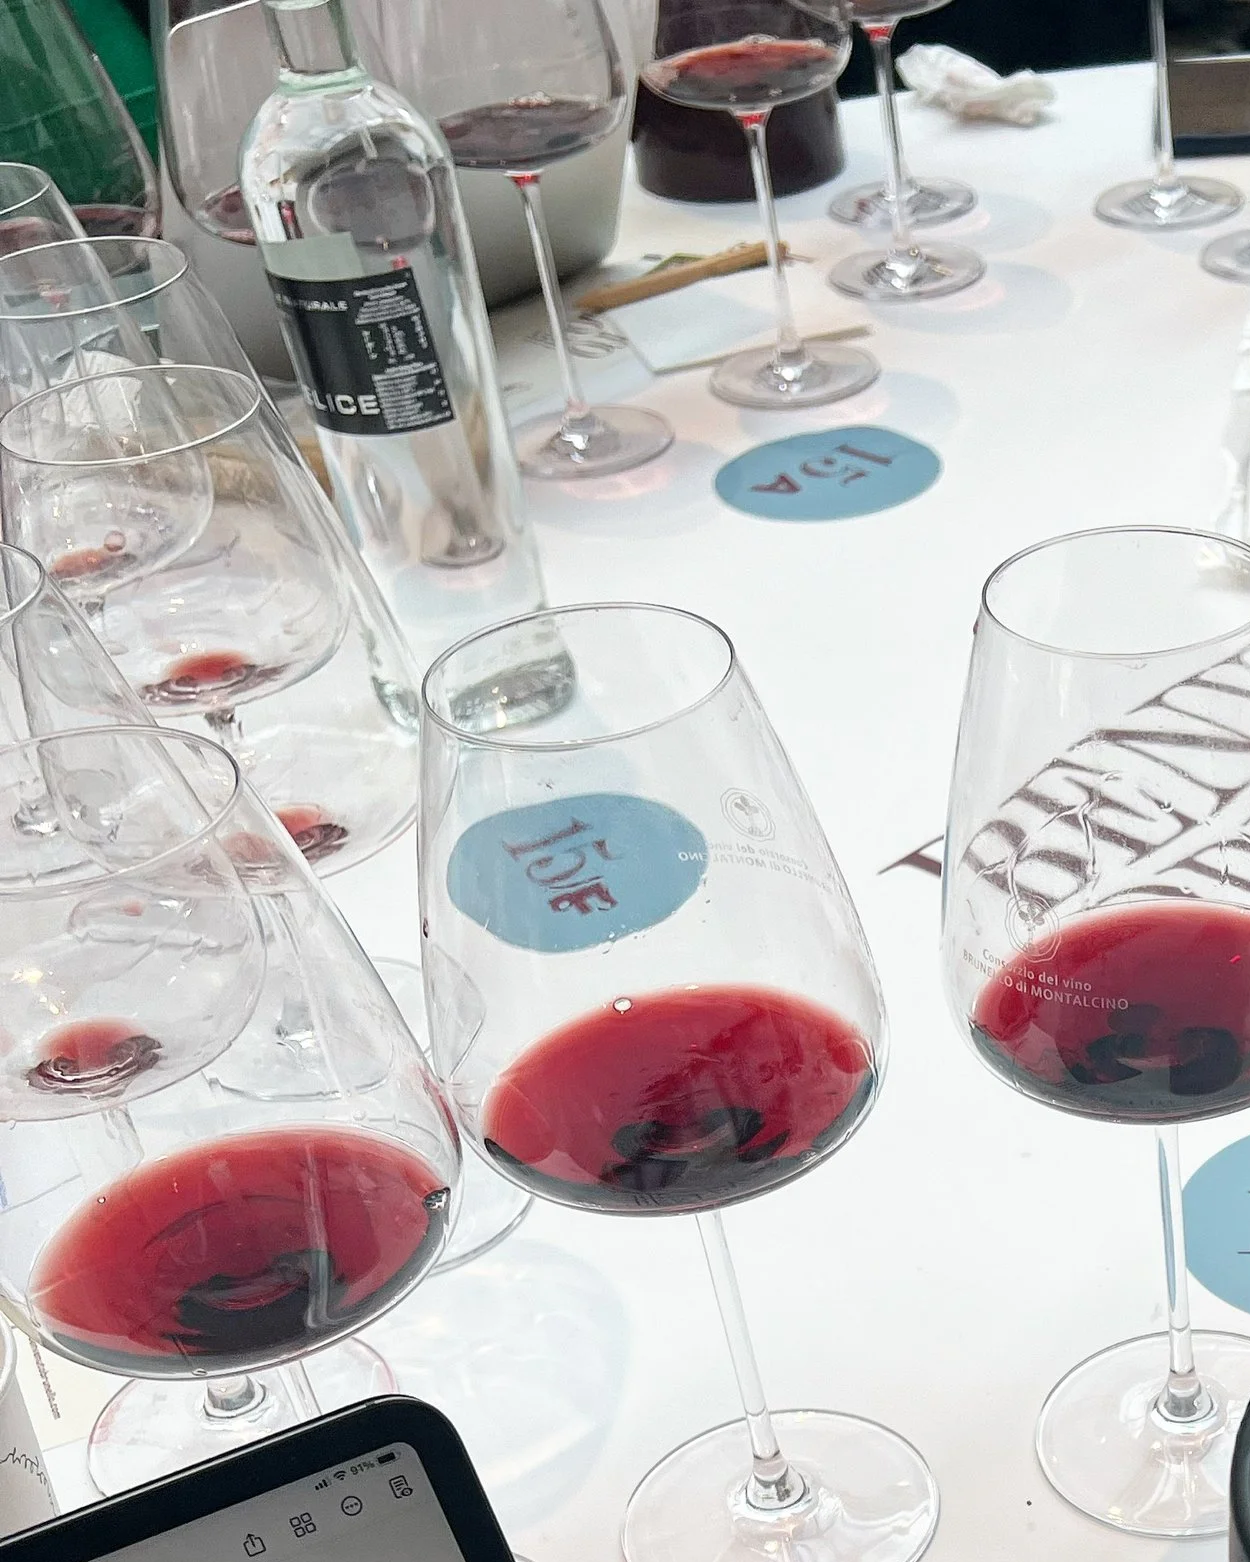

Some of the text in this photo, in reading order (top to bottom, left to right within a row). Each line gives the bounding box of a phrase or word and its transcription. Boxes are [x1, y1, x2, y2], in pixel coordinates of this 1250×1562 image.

[1038, 971, 1059, 985] del
[1062, 978, 1092, 992] vino
[1016, 980, 1027, 993] di
[1030, 985, 1128, 1010] MONTALCINO
